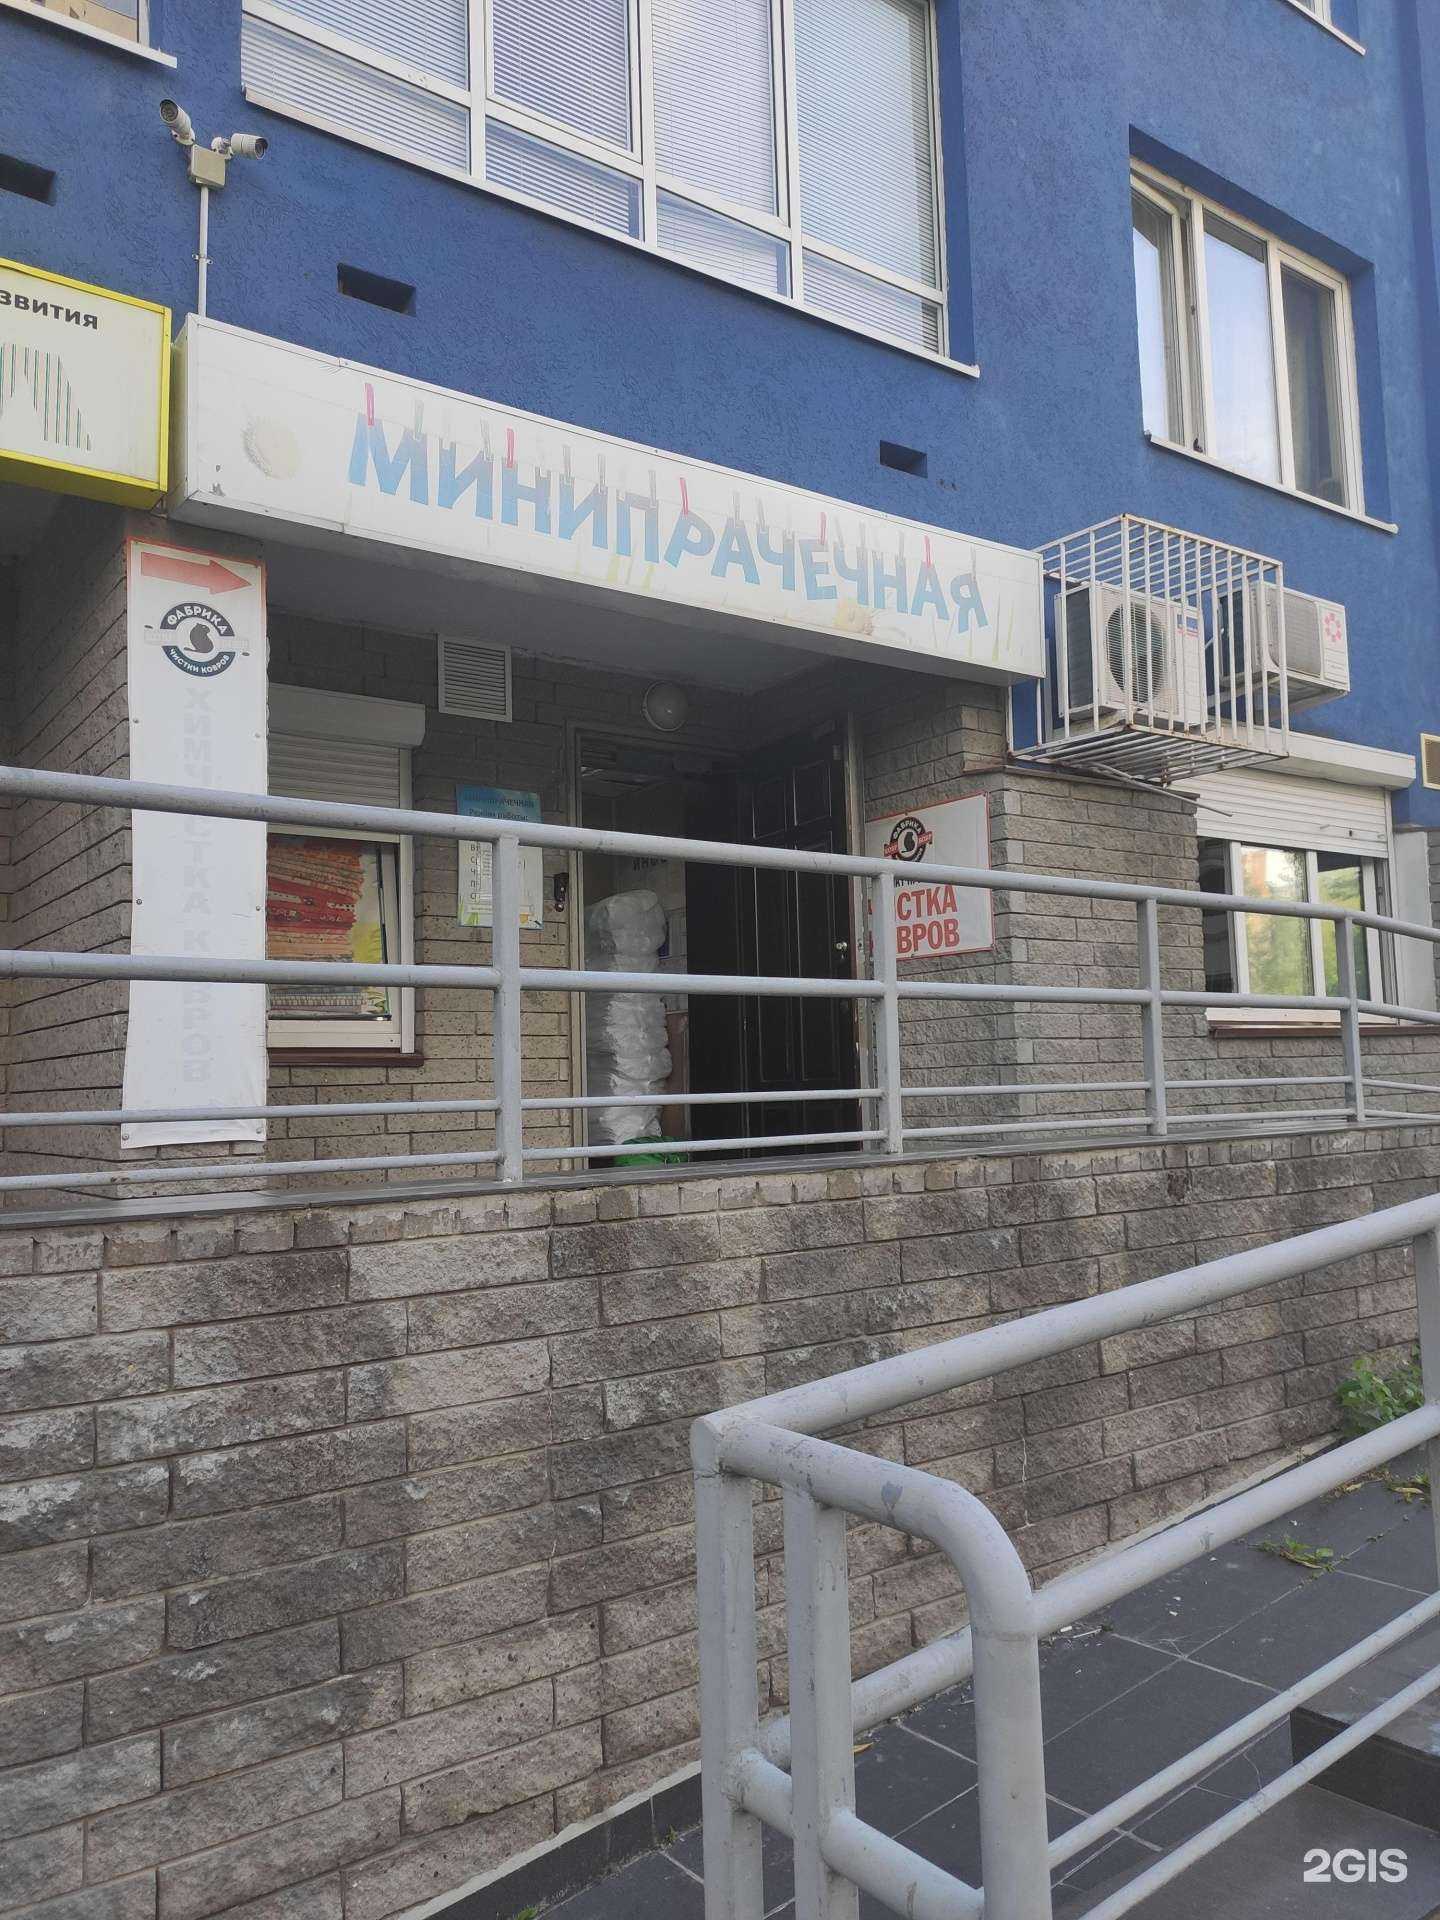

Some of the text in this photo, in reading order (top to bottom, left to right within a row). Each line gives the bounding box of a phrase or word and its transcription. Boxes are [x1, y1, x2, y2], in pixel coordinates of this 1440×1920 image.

[0, 289, 98, 330] ЗВИТИЯ
[347, 411, 989, 634] МИНИПРАЧЕЧНАЯ
[167, 605, 228, 634] ФАБРИКА
[170, 648, 230, 674] ЧИСТКИ КОВРОВ
[182, 687, 215, 1085] ХИМЧСТКА КВРОВ
[868, 884, 958, 920] СТКА
[868, 918, 960, 954] ВРОВ
